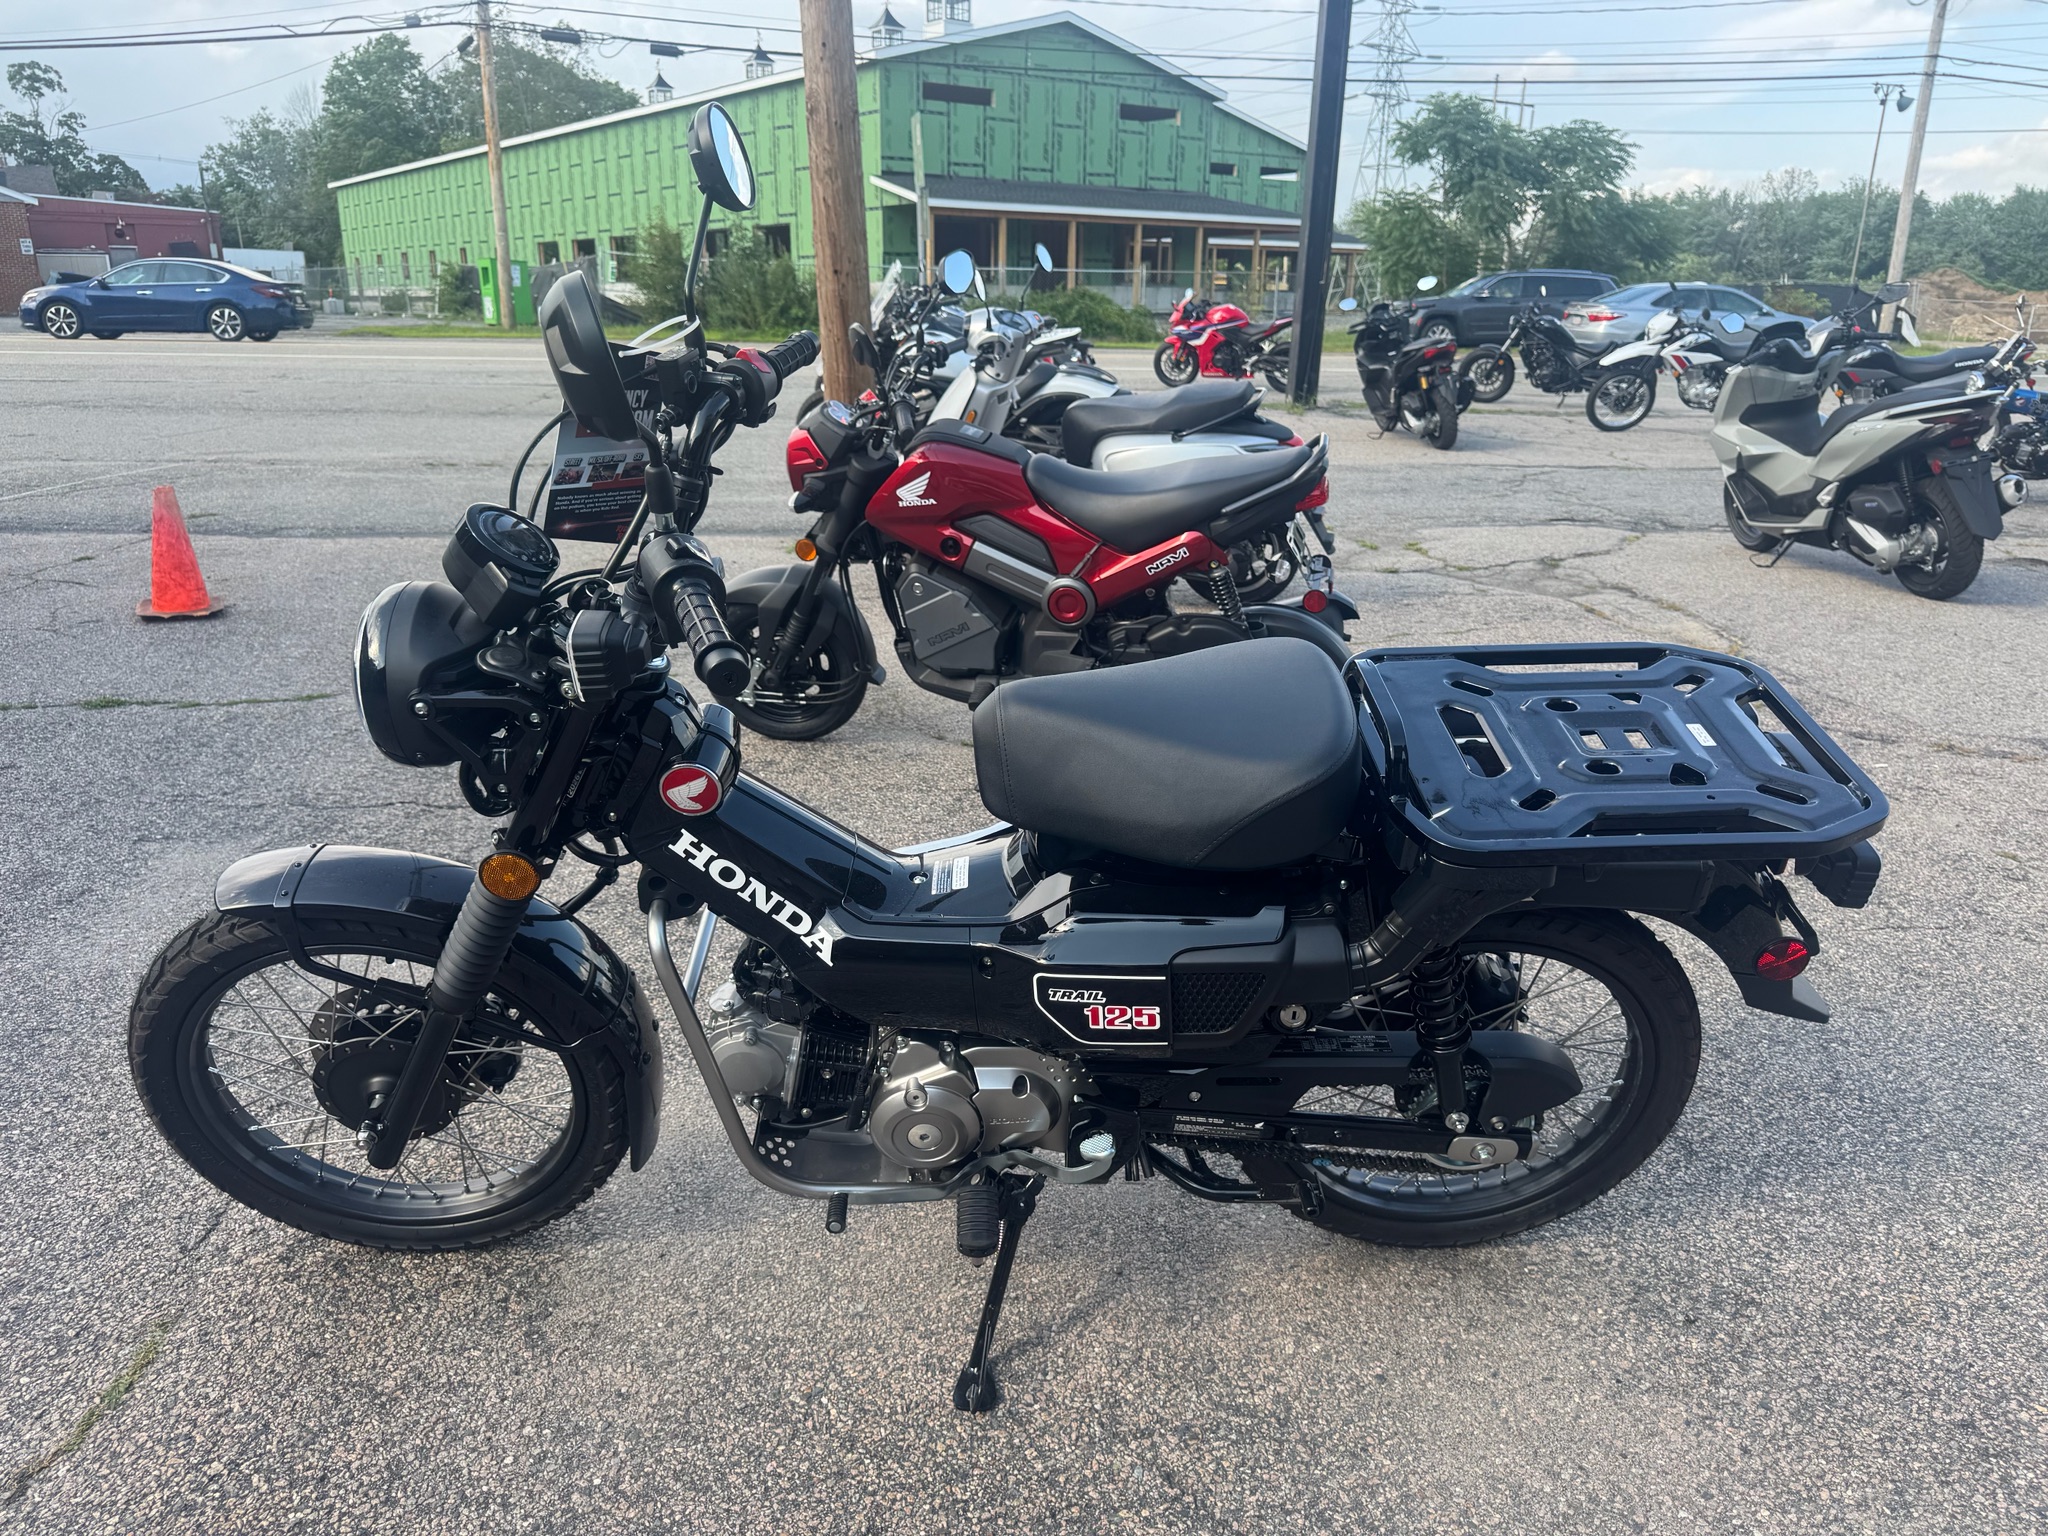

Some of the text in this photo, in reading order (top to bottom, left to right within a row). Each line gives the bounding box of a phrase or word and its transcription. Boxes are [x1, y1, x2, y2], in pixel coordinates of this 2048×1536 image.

[1954, 359, 1985, 368] HONDA
[624, 389, 649, 408] NCY
[897, 498, 937, 507] HONDA
[1145, 546, 1190, 576] NAVI
[927, 621, 970, 647] NAVI
[668, 828, 834, 967] HONDA
[1048, 988, 1107, 1003] TRAIL
[1084, 1005, 1160, 1030] 125
